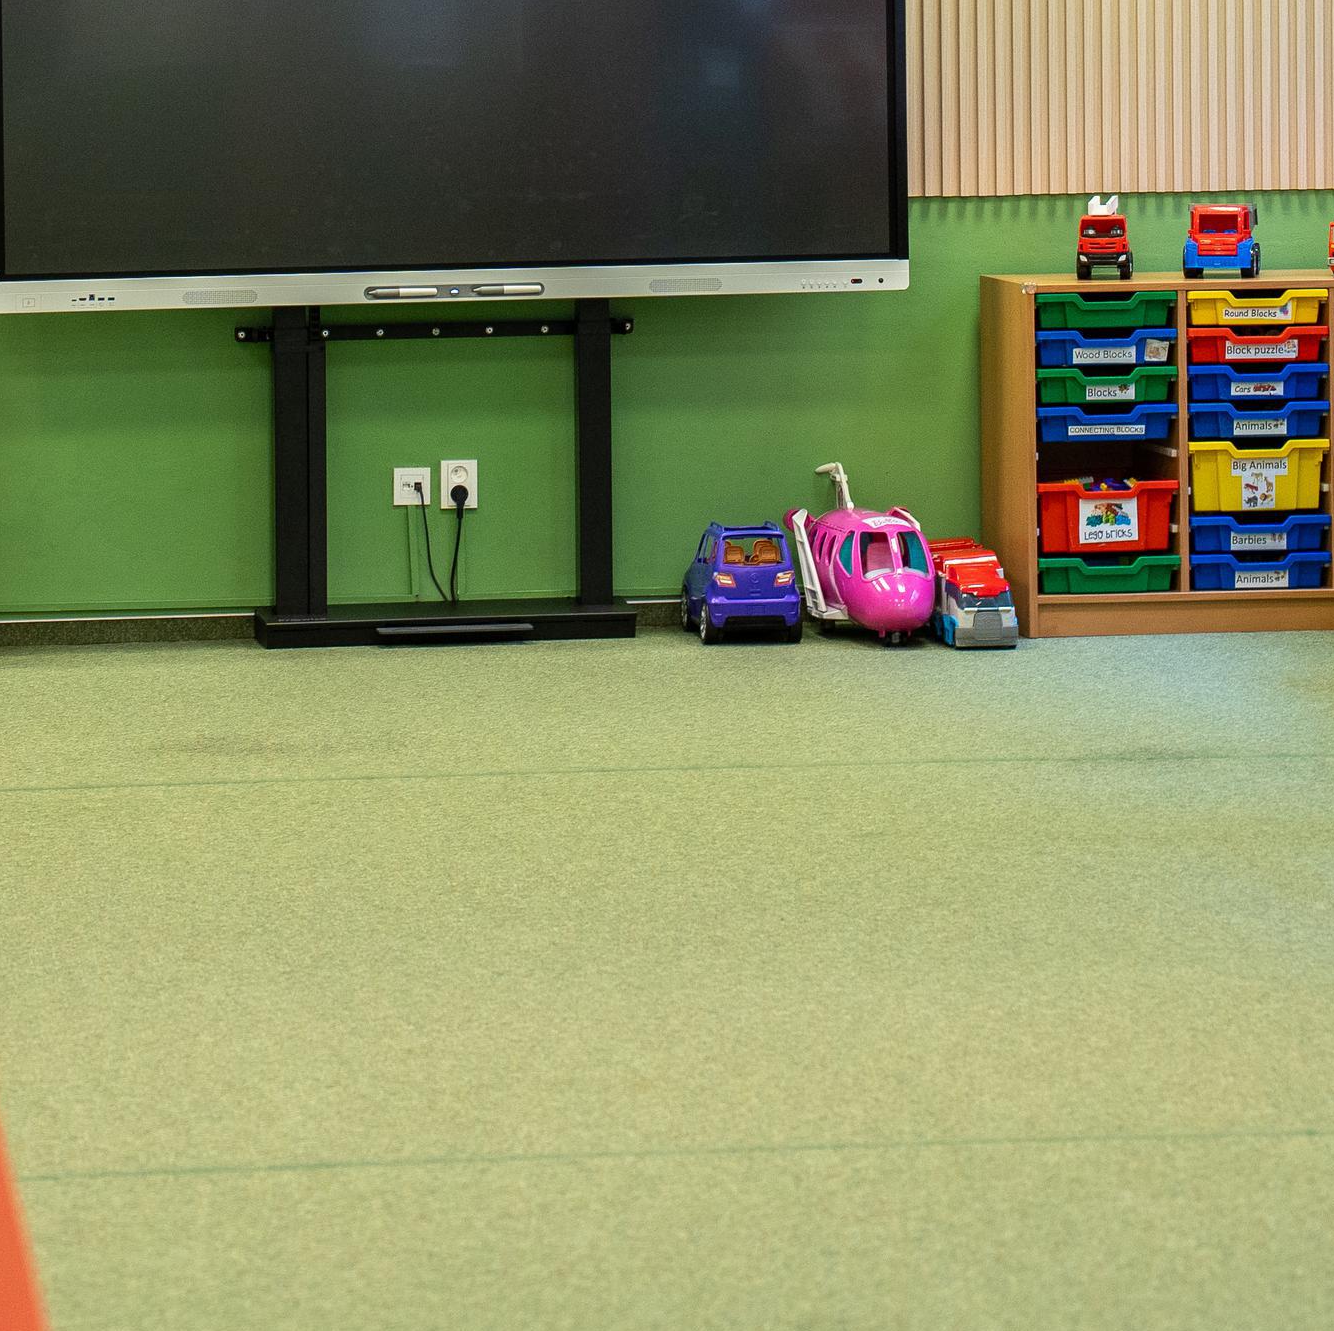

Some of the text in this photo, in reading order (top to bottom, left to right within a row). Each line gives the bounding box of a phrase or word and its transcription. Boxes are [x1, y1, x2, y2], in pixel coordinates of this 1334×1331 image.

[1224, 309, 1277, 318] Round Blocks
[1075, 350, 1132, 360] Wood Blocks
[1227, 345, 1284, 357] Block puzzle
[1088, 387, 1117, 397] Blocks
[1235, 385, 1251, 393] Cars
[1069, 426, 1144, 434] CONNECTING BLOCKS
[1235, 420, 1272, 430] Animals
[1233, 460, 1287, 471] Big Animals
[1084, 528, 1133, 541] Lego bricks
[1232, 535, 1267, 545] Barbies
[1236, 574, 1274, 584] Animals
